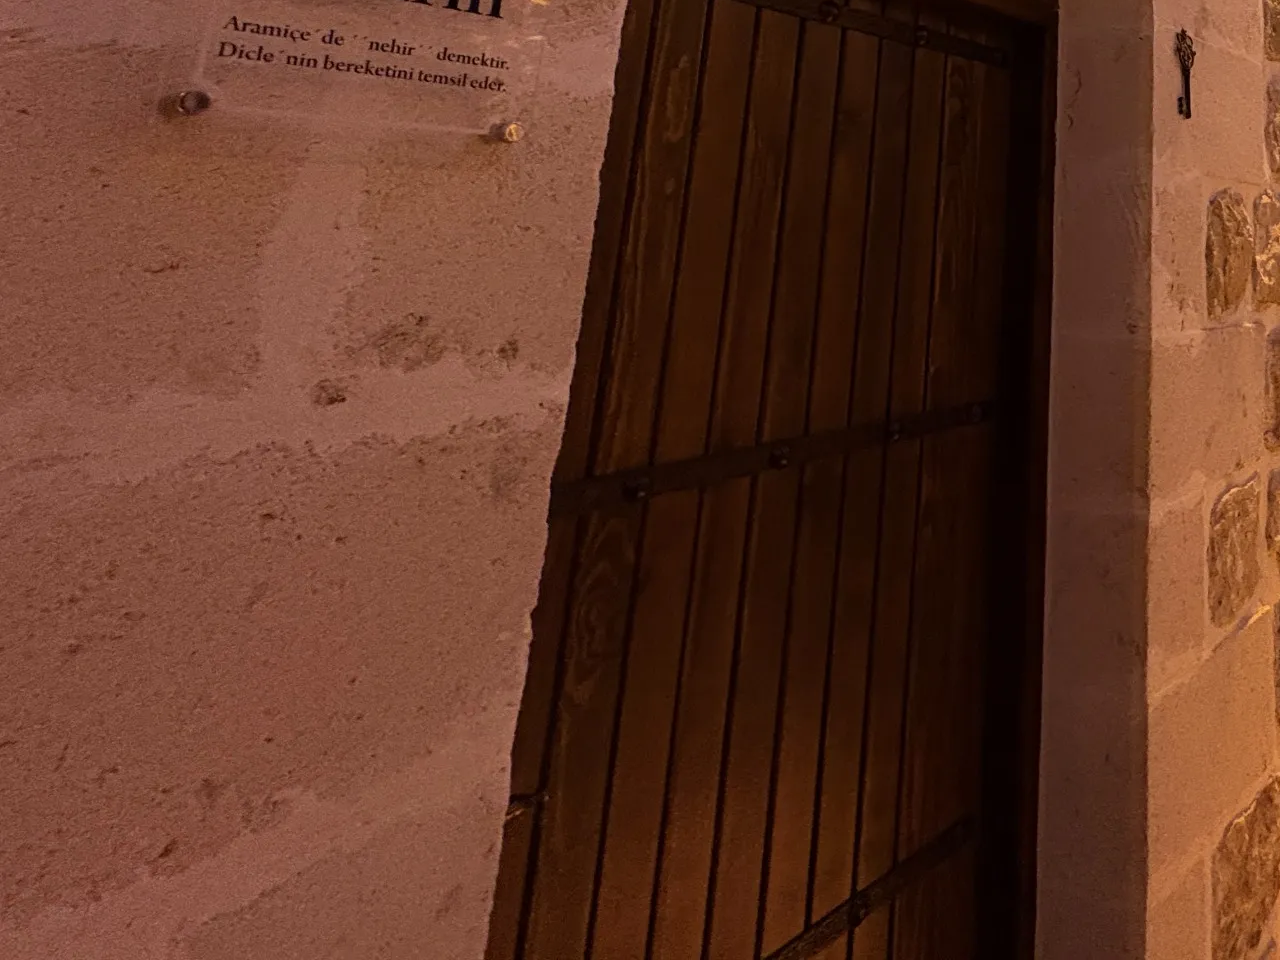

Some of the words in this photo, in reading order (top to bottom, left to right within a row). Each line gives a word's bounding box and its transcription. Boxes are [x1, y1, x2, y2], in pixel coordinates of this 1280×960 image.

[323, 54, 414, 81] bereketini
[417, 70, 468, 87] temsil
[468, 76, 507, 92] eder.
[436, 46, 511, 70] demektir.
